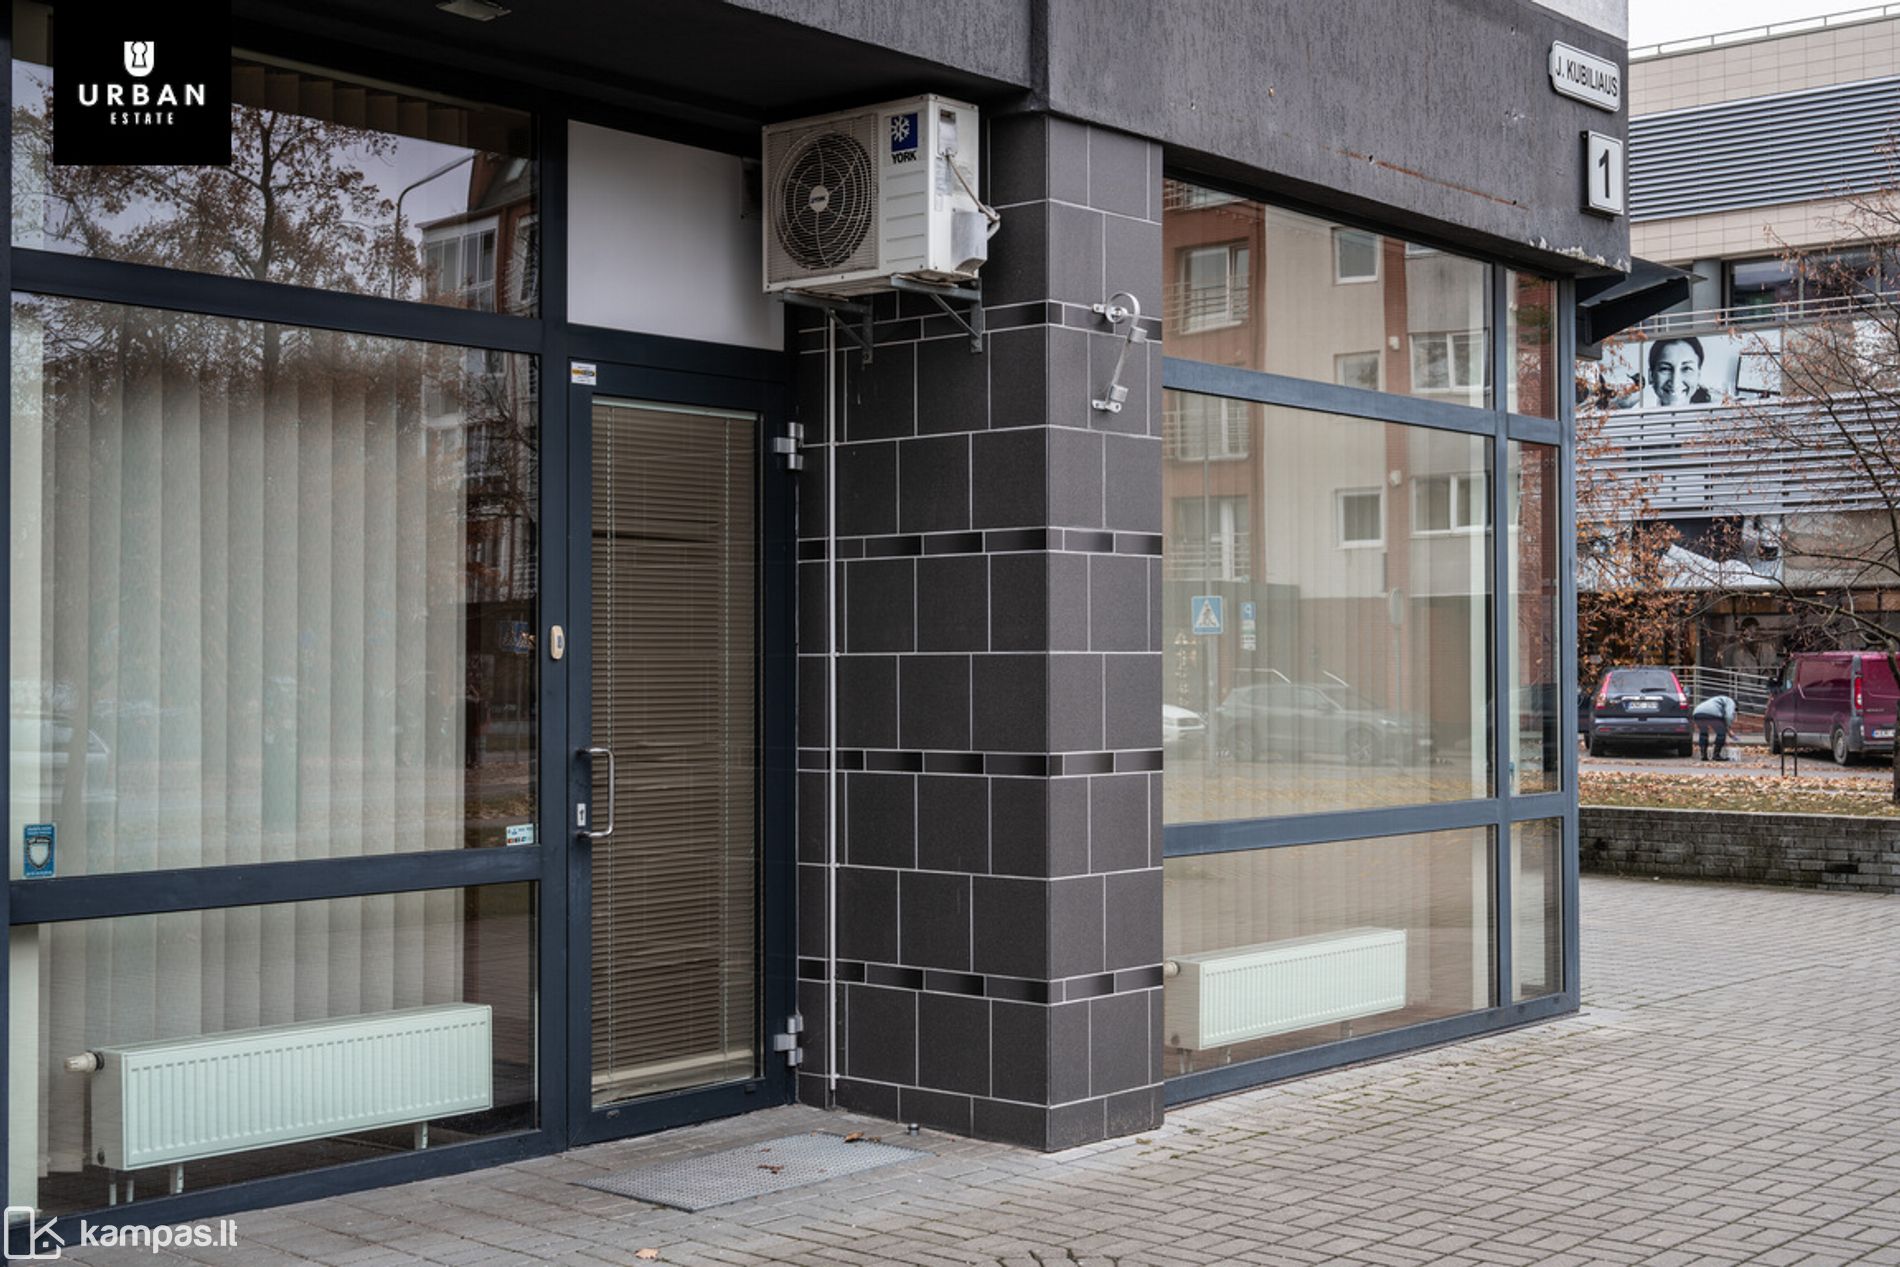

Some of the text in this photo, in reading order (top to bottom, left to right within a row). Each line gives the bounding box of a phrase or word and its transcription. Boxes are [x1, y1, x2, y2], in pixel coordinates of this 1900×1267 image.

[1555, 55, 1618, 97] J. KUBILIAUS
[890, 150, 917, 164] YORK
[1598, 149, 1610, 199] 1
